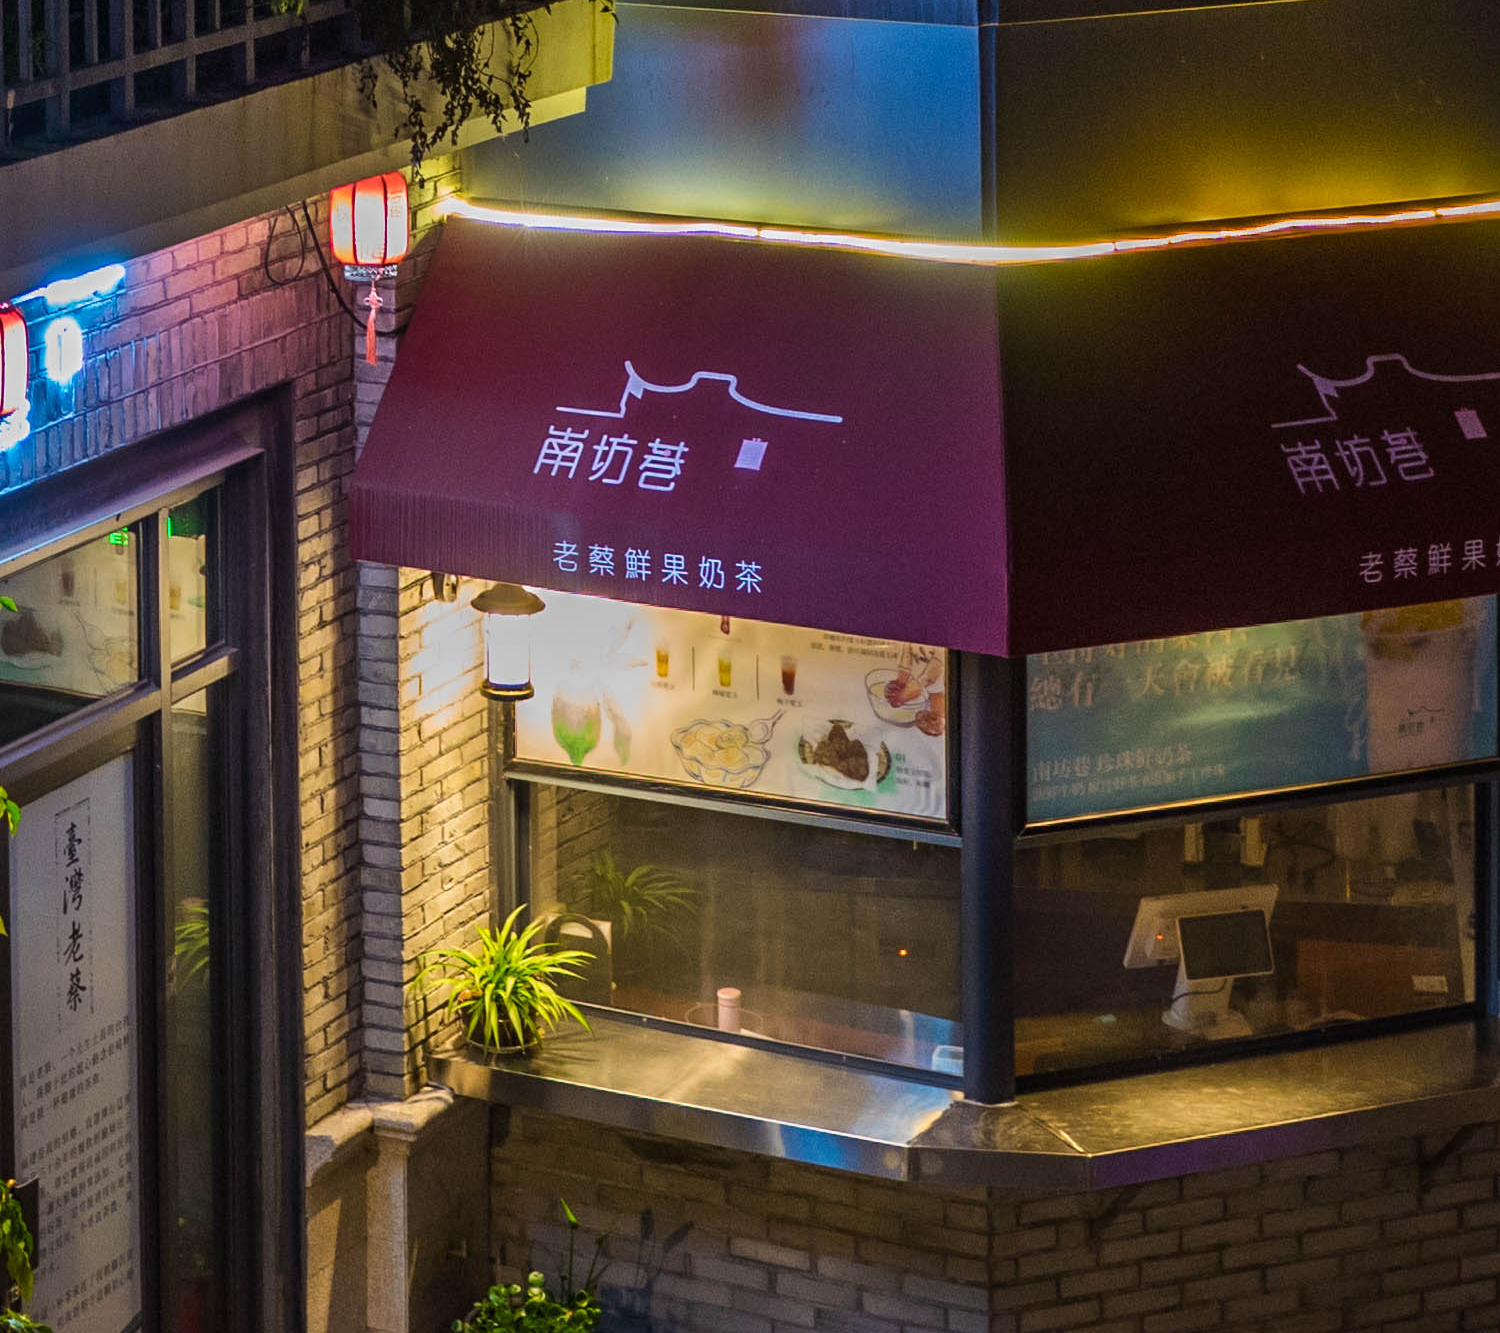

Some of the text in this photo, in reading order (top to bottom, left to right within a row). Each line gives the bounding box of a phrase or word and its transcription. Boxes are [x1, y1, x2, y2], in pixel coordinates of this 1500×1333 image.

[533, 425, 689, 491] 南坊巷
[1280, 427, 1435, 493] 南坊巷
[552, 540, 763, 593] 老蔡鮮果奶茶
[63, 821, 87, 1012] 臺灣老蔡
